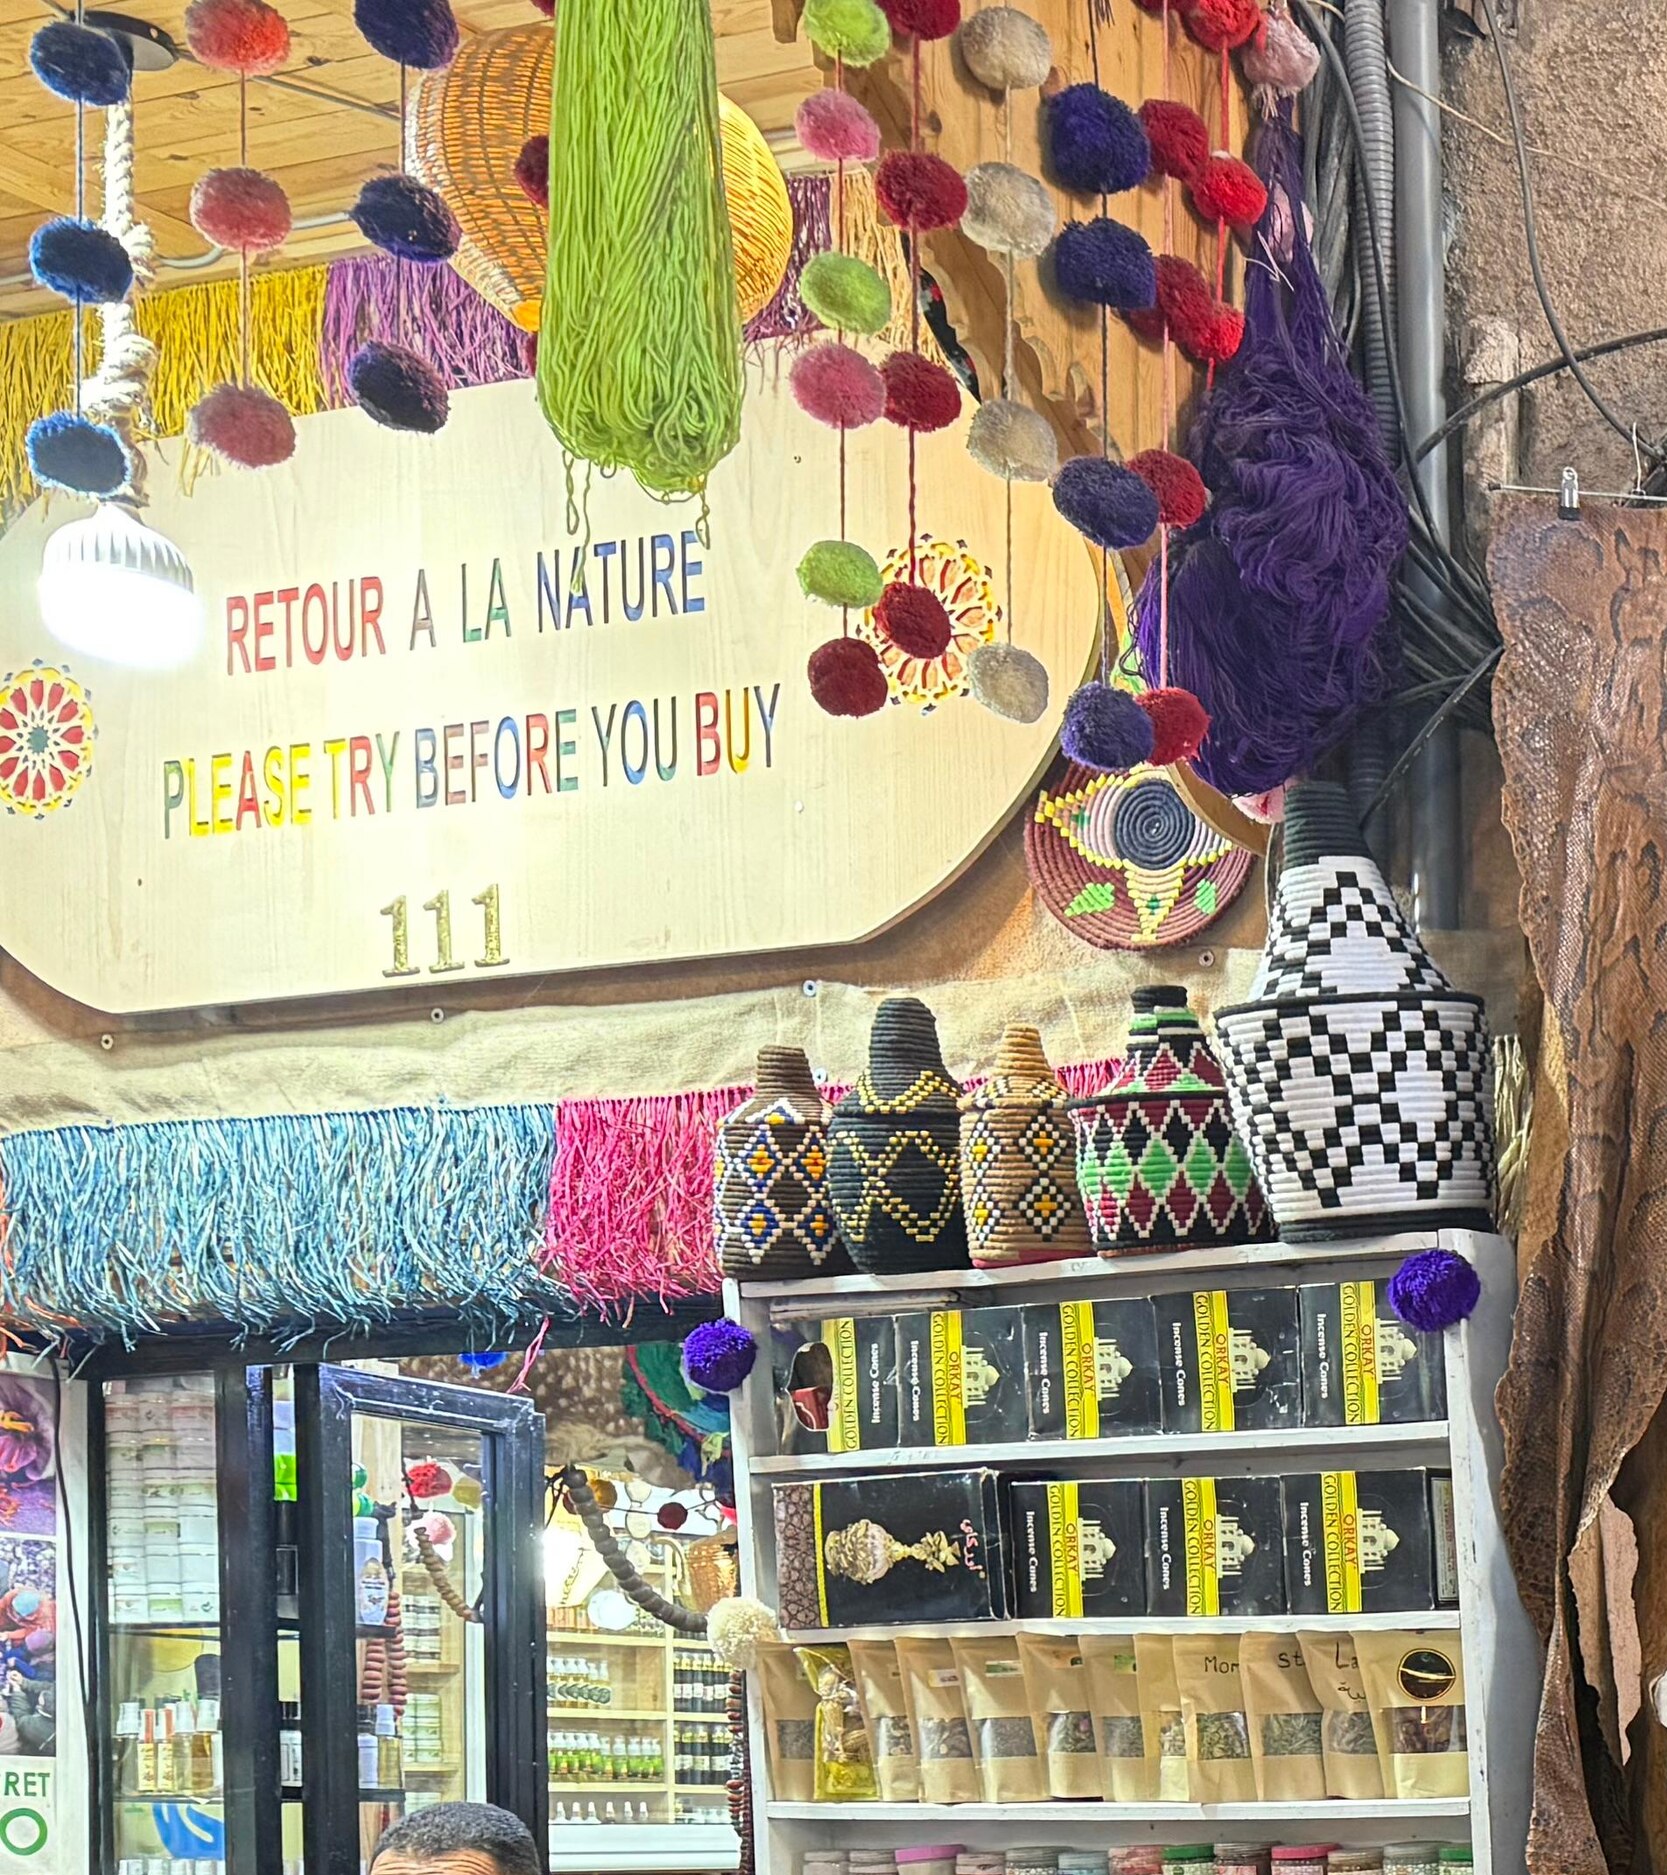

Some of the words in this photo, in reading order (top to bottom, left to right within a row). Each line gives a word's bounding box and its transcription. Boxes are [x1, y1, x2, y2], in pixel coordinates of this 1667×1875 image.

[226, 575, 386, 676] RETOUR
[409, 568, 437, 651] A
[461, 557, 512, 643] LA
[537, 530, 706, 634] NATURE
[163, 742, 313, 839] PLEASE
[323, 731, 401, 820] TRY
[414, 708, 580, 810] BEFORE
[591, 696, 678, 788] YOU
[695, 682, 782, 777] BUY
[379, 883, 511, 978] 111
[1061, 1304, 1077, 1356] GOLDEN
[1195, 1294, 1209, 1347] GOLDEN
[1316, 1312, 1328, 1360] Incense
[1341, 1285, 1357, 1338] GOLDEN
[839, 1320, 857, 1396] COLLECTION
[869, 1342, 880, 1379] Cones
[910, 1340, 920, 1385] Incense
[931, 1312, 946, 1366] GOLDEN
[1038, 1331, 1049, 1376] Incense
[1171, 1322, 1183, 1368] Incense
[1214, 1333, 1230, 1385] ORKAY
[1360, 1324, 1376, 1377] ORKAY
[949, 1352, 963, 1406] ORKAY
[1081, 1342, 1096, 1393] ORKAY
[1175, 1370, 1187, 1407] Cones
[1199, 1350, 1217, 1430] COLLECTION
[1319, 1361, 1330, 1400] Cones
[1345, 1342, 1361, 1423] COLLECTION
[870, 1381, 881, 1424] Incense
[911, 1386, 921, 1422] Cones
[934, 1368, 948, 1444] COLLECTION
[1040, 1378, 1051, 1415] Cones
[1066, 1360, 1080, 1438] COLLECTION
[842, 1399, 858, 1449] GOLDEN
[1049, 1484, 1063, 1536] GOLDEN
[1184, 1480, 1199, 1532] GOLDEN
[1299, 1501, 1310, 1548] Incense
[1322, 1474, 1338, 1527] GOLDEN
[1025, 1511, 1036, 1556] Incense
[1065, 1522, 1079, 1573] ORKAY
[1159, 1506, 1170, 1552] Incense
[1203, 1519, 1217, 1571] ORKAY
[1342, 1513, 1358, 1566] ORKAY
[1027, 1557, 1039, 1593] Cones
[1052, 1539, 1067, 1617] COLLECTION
[1161, 1553, 1172, 1591] Cones
[1187, 1536, 1203, 1614] COLLECTION
[1302, 1549, 1313, 1587] Cones
[1326, 1530, 1343, 1612] COLLECTION
[0, 1771, 51, 1798] RET
